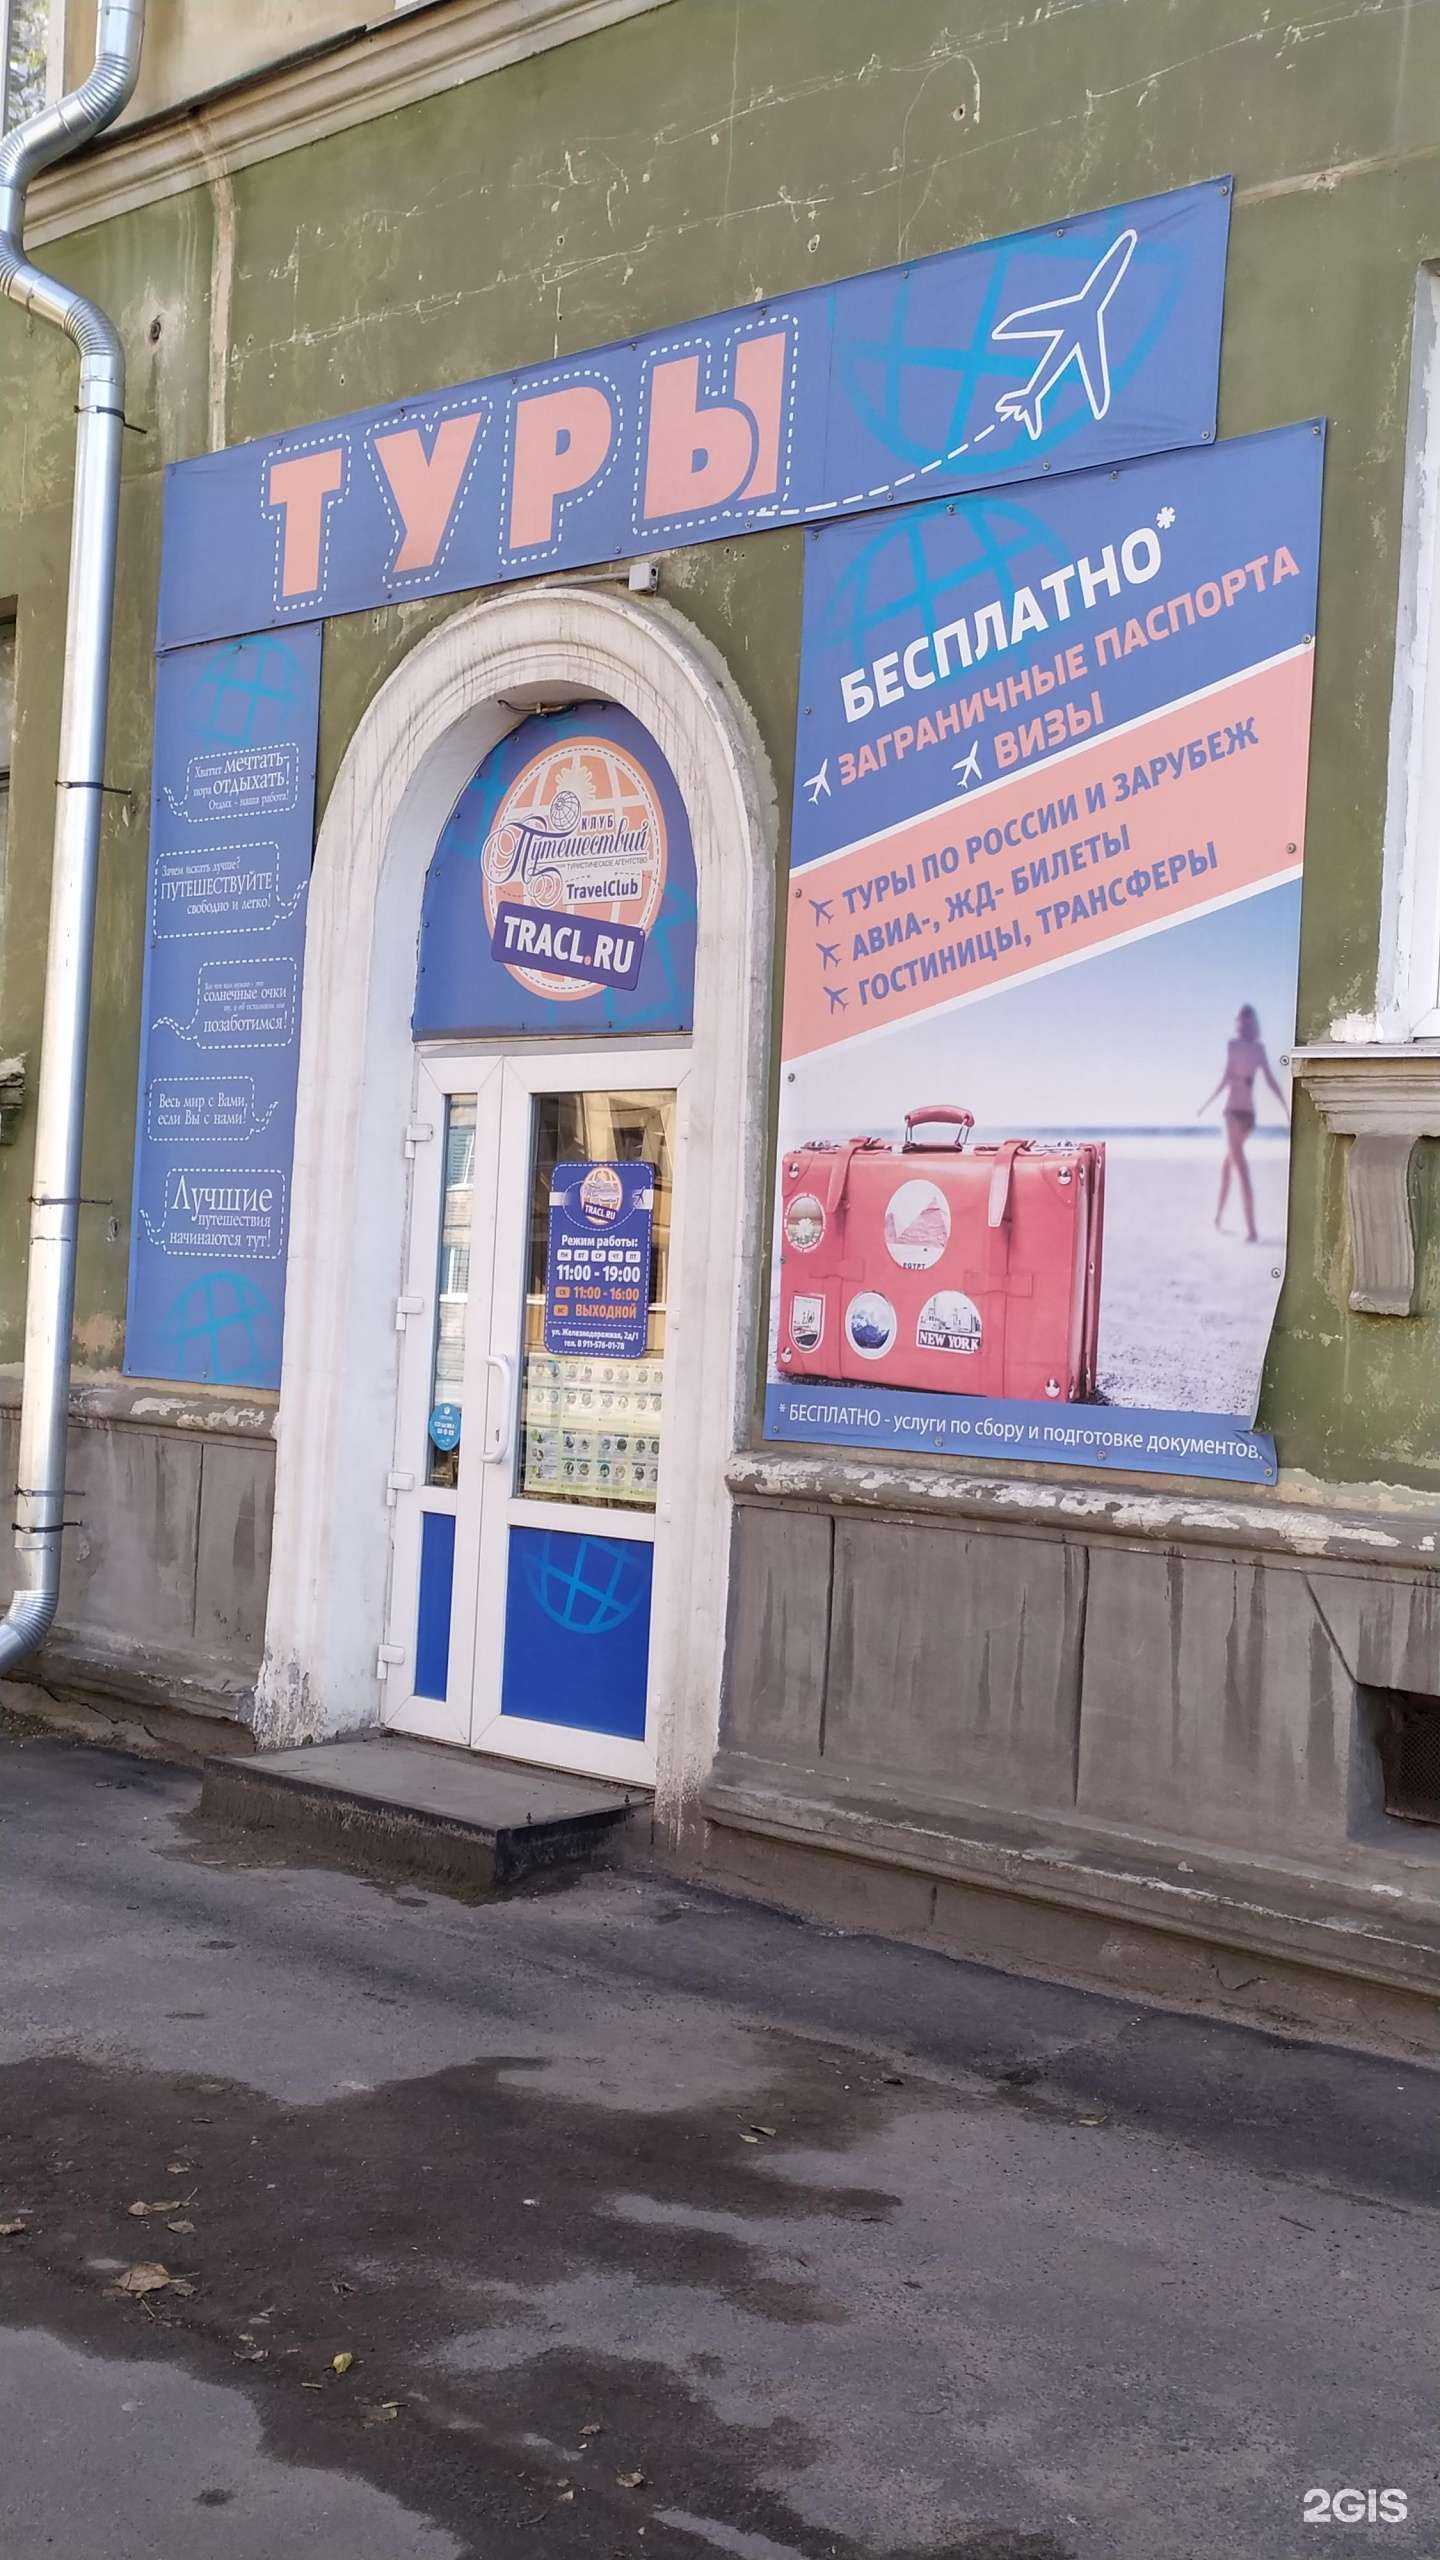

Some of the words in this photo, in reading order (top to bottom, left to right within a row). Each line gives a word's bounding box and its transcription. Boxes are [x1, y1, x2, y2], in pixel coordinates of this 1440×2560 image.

[269, 332, 785, 597] ТУРЫ
[838, 645, 1088, 786] ЗАГРАНИЧНЫЕ
[1096, 546, 1300, 667] ПАСПОРТА
[993, 692, 1103, 770] ВИЗЫ
[581, 815, 613, 830] КЛУБ
[842, 863, 915, 915] ТУРЫ
[922, 846, 959, 884] ПО
[966, 793, 1079, 864] РОССИИ
[1084, 783, 1106, 811] И
[1112, 716, 1259, 802] ЗАРУБЕЖ
[482, 815, 649, 907] Путешествий
[160, 871, 273, 902] ПУТЕШЕСТВУЙТЕ
[567, 878, 638, 899] TravelClub
[852, 914, 941, 961] АВИА-,
[947, 883, 1005, 923] ЖД-
[1012, 824, 1130, 896] БИЛЕТЫ
[186, 900, 229, 914] свободно
[232, 901, 239, 910] и
[241, 893, 271, 911] легко!
[859, 920, 1031, 1006] ГОСТИНИЦЫ,
[1035, 841, 1218, 936] ТРАНСФЕРЫ
[503, 915, 635, 973] TRACL.RU
[203, 989, 257, 1002] солнечные
[260, 987, 287, 999] очки
[203, 1011, 288, 1032] позаботимся!
[159, 1093, 180, 1108] Весь
[183, 1097, 204, 1112] мир
[208, 1098, 214, 1107] с
[218, 1092, 248, 1108] Вами,
[157, 1114, 180, 1125] если
[185, 1110, 200, 1125] Вы
[204, 1115, 210, 1125] с
[214, 1107, 246, 1125] нами!
[170, 1175, 273, 1221] Лучшие
[198, 1214, 271, 1230] путешествия
[585, 1205, 616, 1220] TRACL.RU
[169, 1231, 241, 1247] начинаются
[246, 1228, 271, 1252] тут!
[561, 1234, 595, 1246] Режим
[597, 1235, 638, 1249] работы:
[556, 1264, 591, 1281] 11:00
[602, 1265, 640, 1282] 19:00
[574, 1286, 600, 1299] 11:00
[610, 1287, 640, 1301] 16:00
[575, 1303, 636, 1319] ВЫХОДНОЙ
[919, 1331, 945, 1347] NEW
[947, 1335, 980, 1351] YORK
[893, 1414, 945, 1434] услуги
[951, 1420, 971, 1434] по
[975, 1418, 1024, 1442] сбору
[1028, 1427, 1039, 1439] и
[1044, 1426, 1143, 1449] подготовке
[1146, 1434, 1263, 1460] документов.
